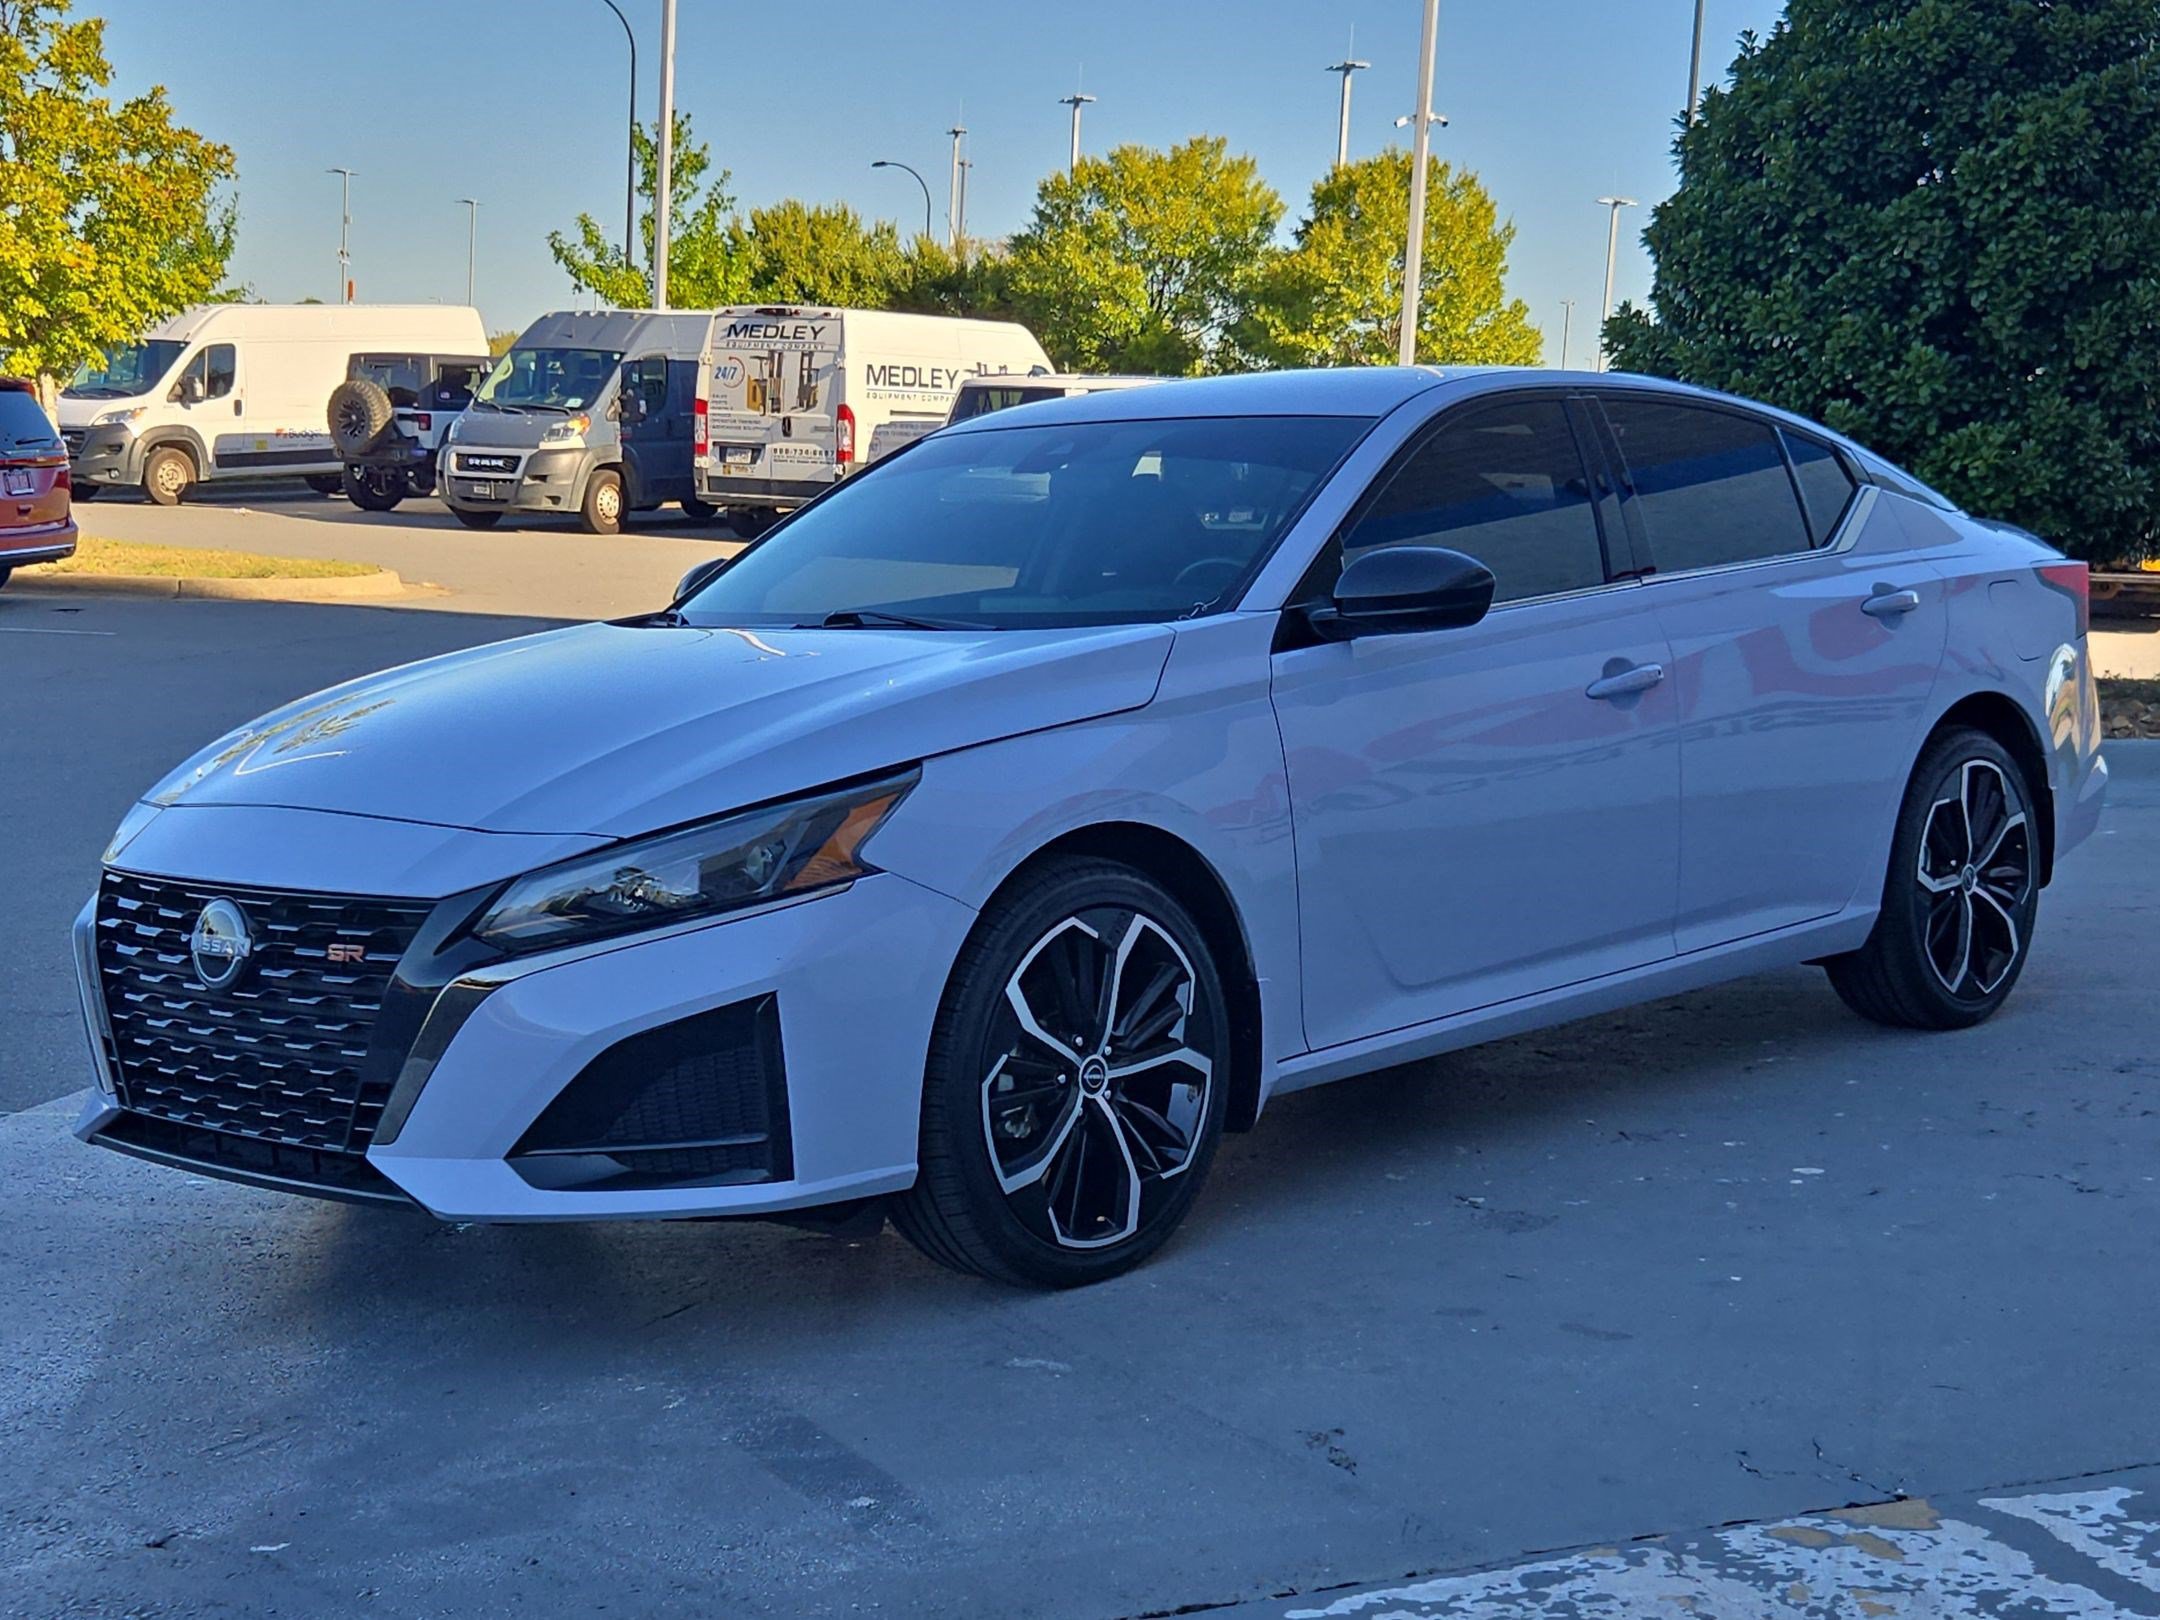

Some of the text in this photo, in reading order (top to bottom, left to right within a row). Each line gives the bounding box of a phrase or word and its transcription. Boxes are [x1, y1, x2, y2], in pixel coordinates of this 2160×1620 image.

[726, 323, 826, 340] MEDLEY
[714, 366, 738, 380] 24/7
[866, 363, 959, 389] MEDLEY
[467, 458, 504, 468] RAM
[328, 943, 365, 963] SR
